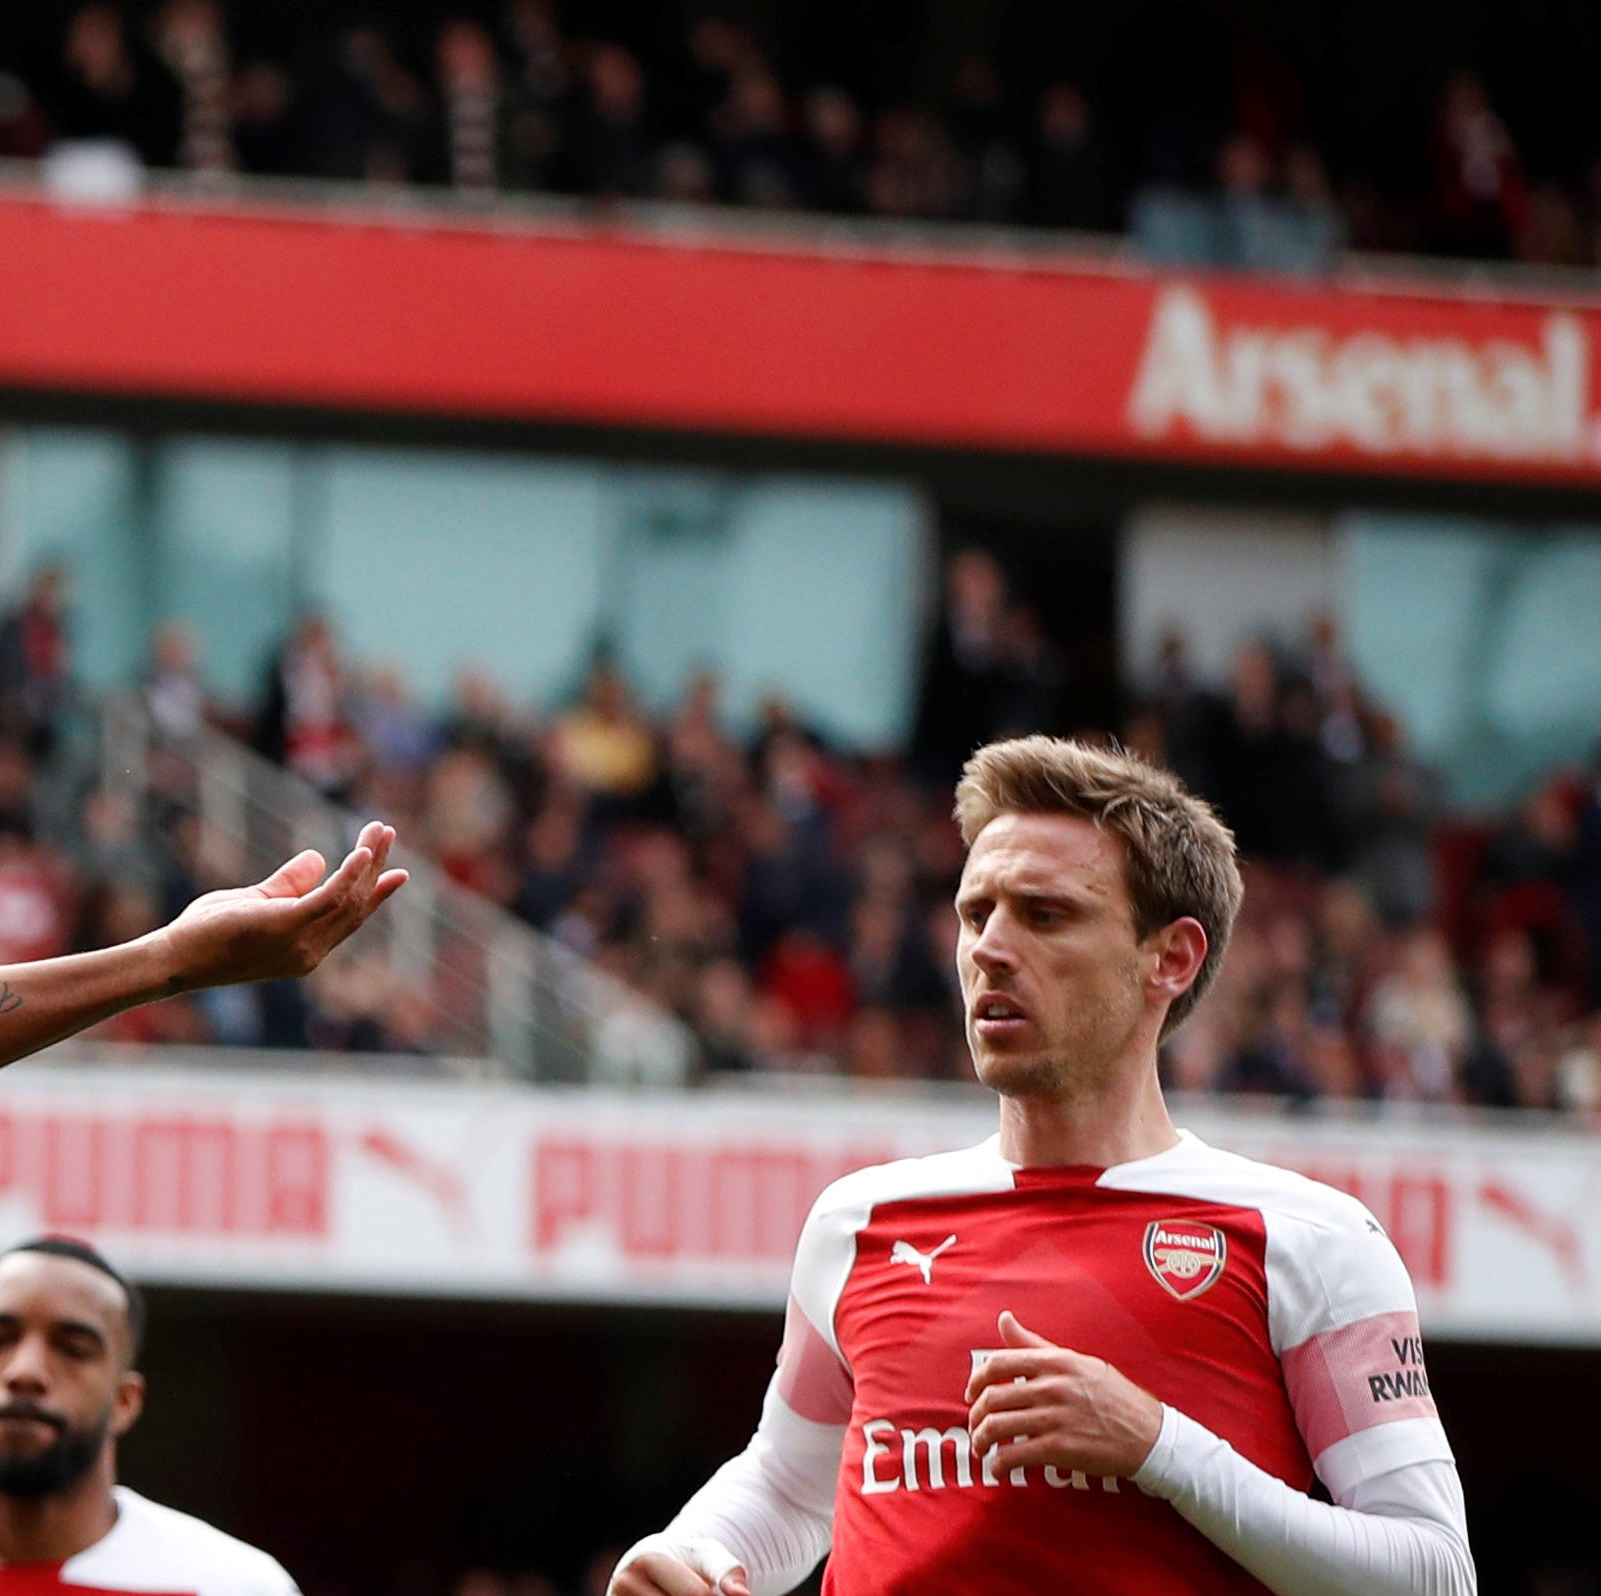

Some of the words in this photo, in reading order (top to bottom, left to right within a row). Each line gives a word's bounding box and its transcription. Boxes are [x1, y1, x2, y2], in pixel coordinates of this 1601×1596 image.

[1129, 284, 1586, 460] Arsenal
[533, 1138, 898, 1262] PUM
[1155, 1229, 1216, 1251] Arsenal
[1391, 1336, 1424, 1366] VIS
